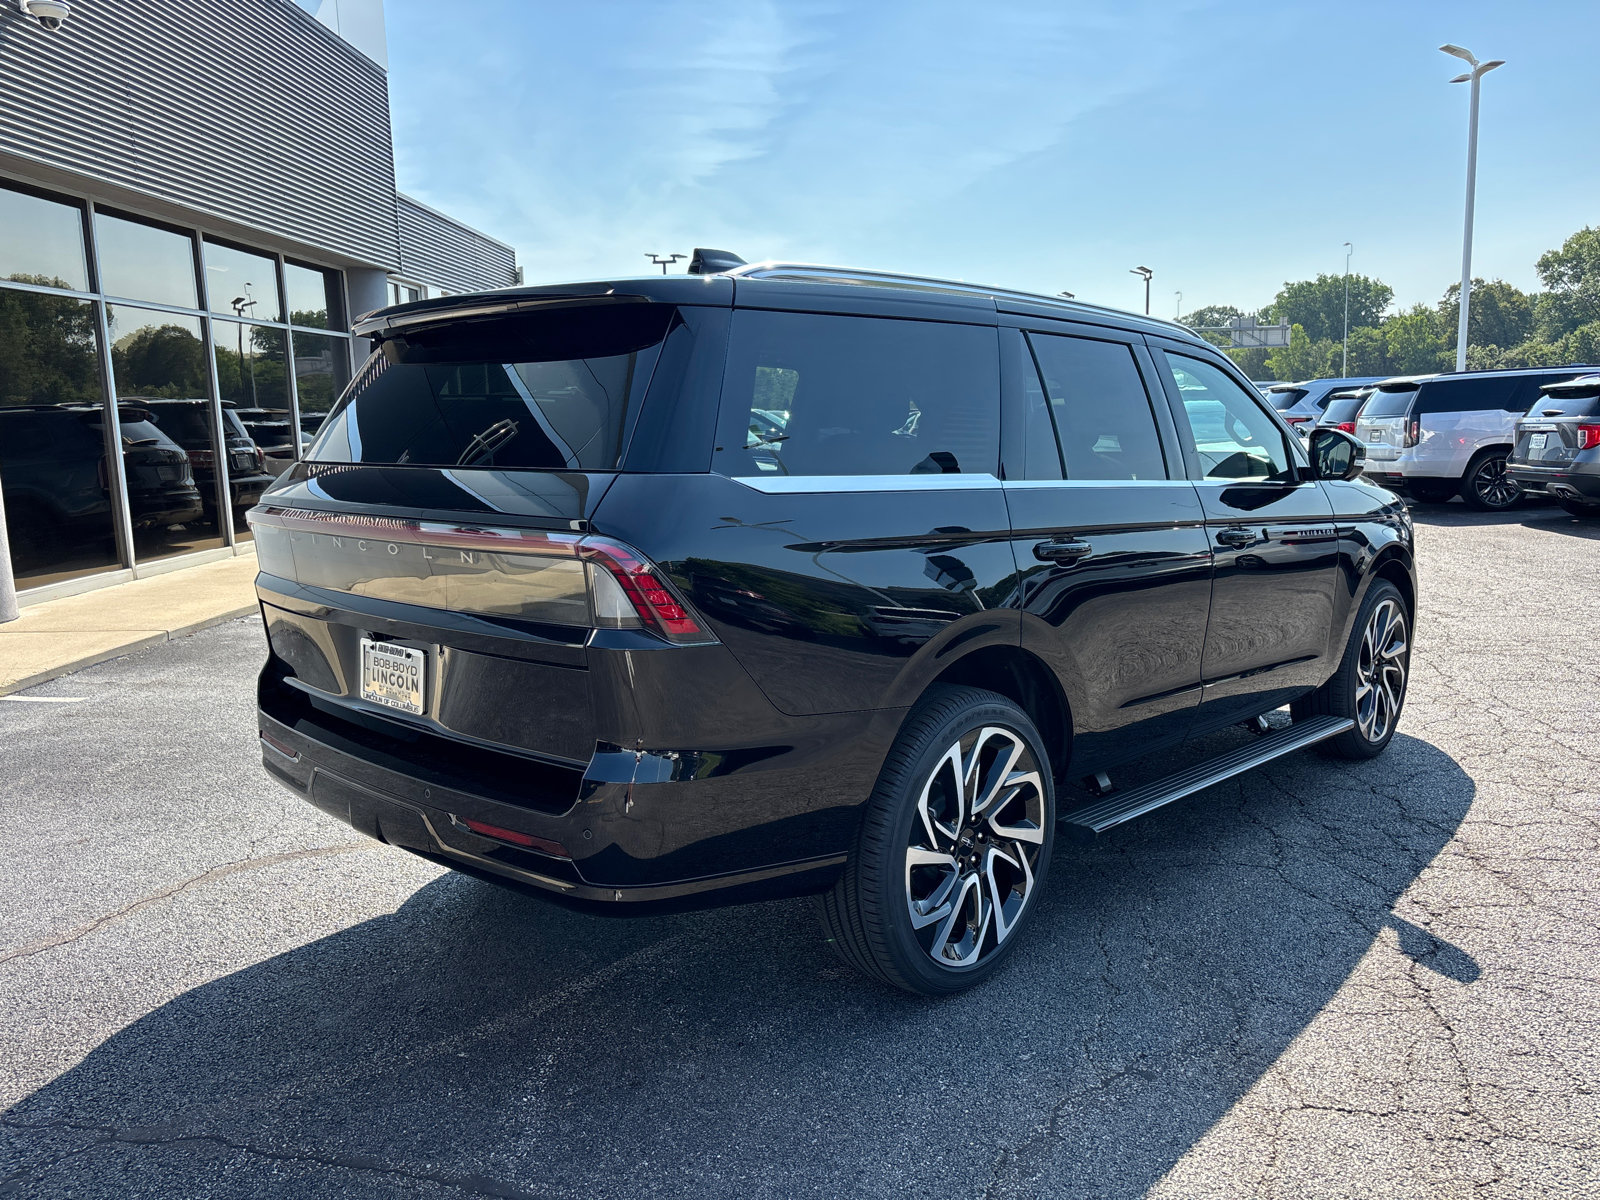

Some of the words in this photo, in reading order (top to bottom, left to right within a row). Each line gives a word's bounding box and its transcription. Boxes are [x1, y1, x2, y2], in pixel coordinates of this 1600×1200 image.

[1297, 529, 1334, 537] NAVIGATOR
[289, 531, 474, 564] LINCOLN
[373, 656, 418, 676] BOB-BOYD
[372, 668, 419, 693] LINCOLN
[363, 692, 383, 703] LINCOLN
